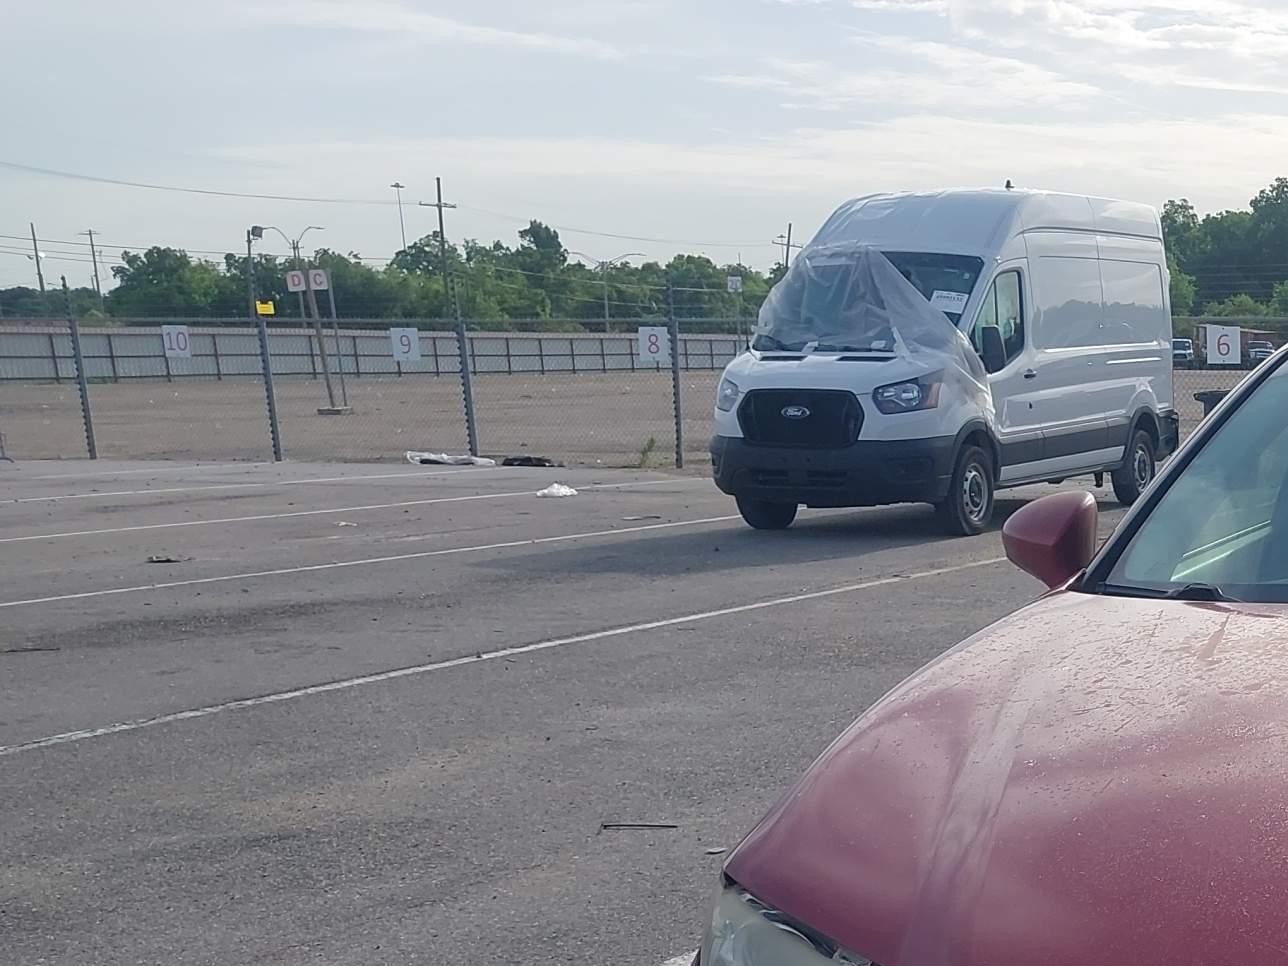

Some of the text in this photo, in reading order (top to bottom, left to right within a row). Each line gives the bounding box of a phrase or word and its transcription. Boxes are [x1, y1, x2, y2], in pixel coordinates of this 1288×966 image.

[290, 274, 301, 287] D
[313, 273, 323, 286] C
[166, 332, 187, 351] 10
[400, 335, 411, 353] 9
[648, 334, 660, 354] 8
[1217, 334, 1230, 356] 6
